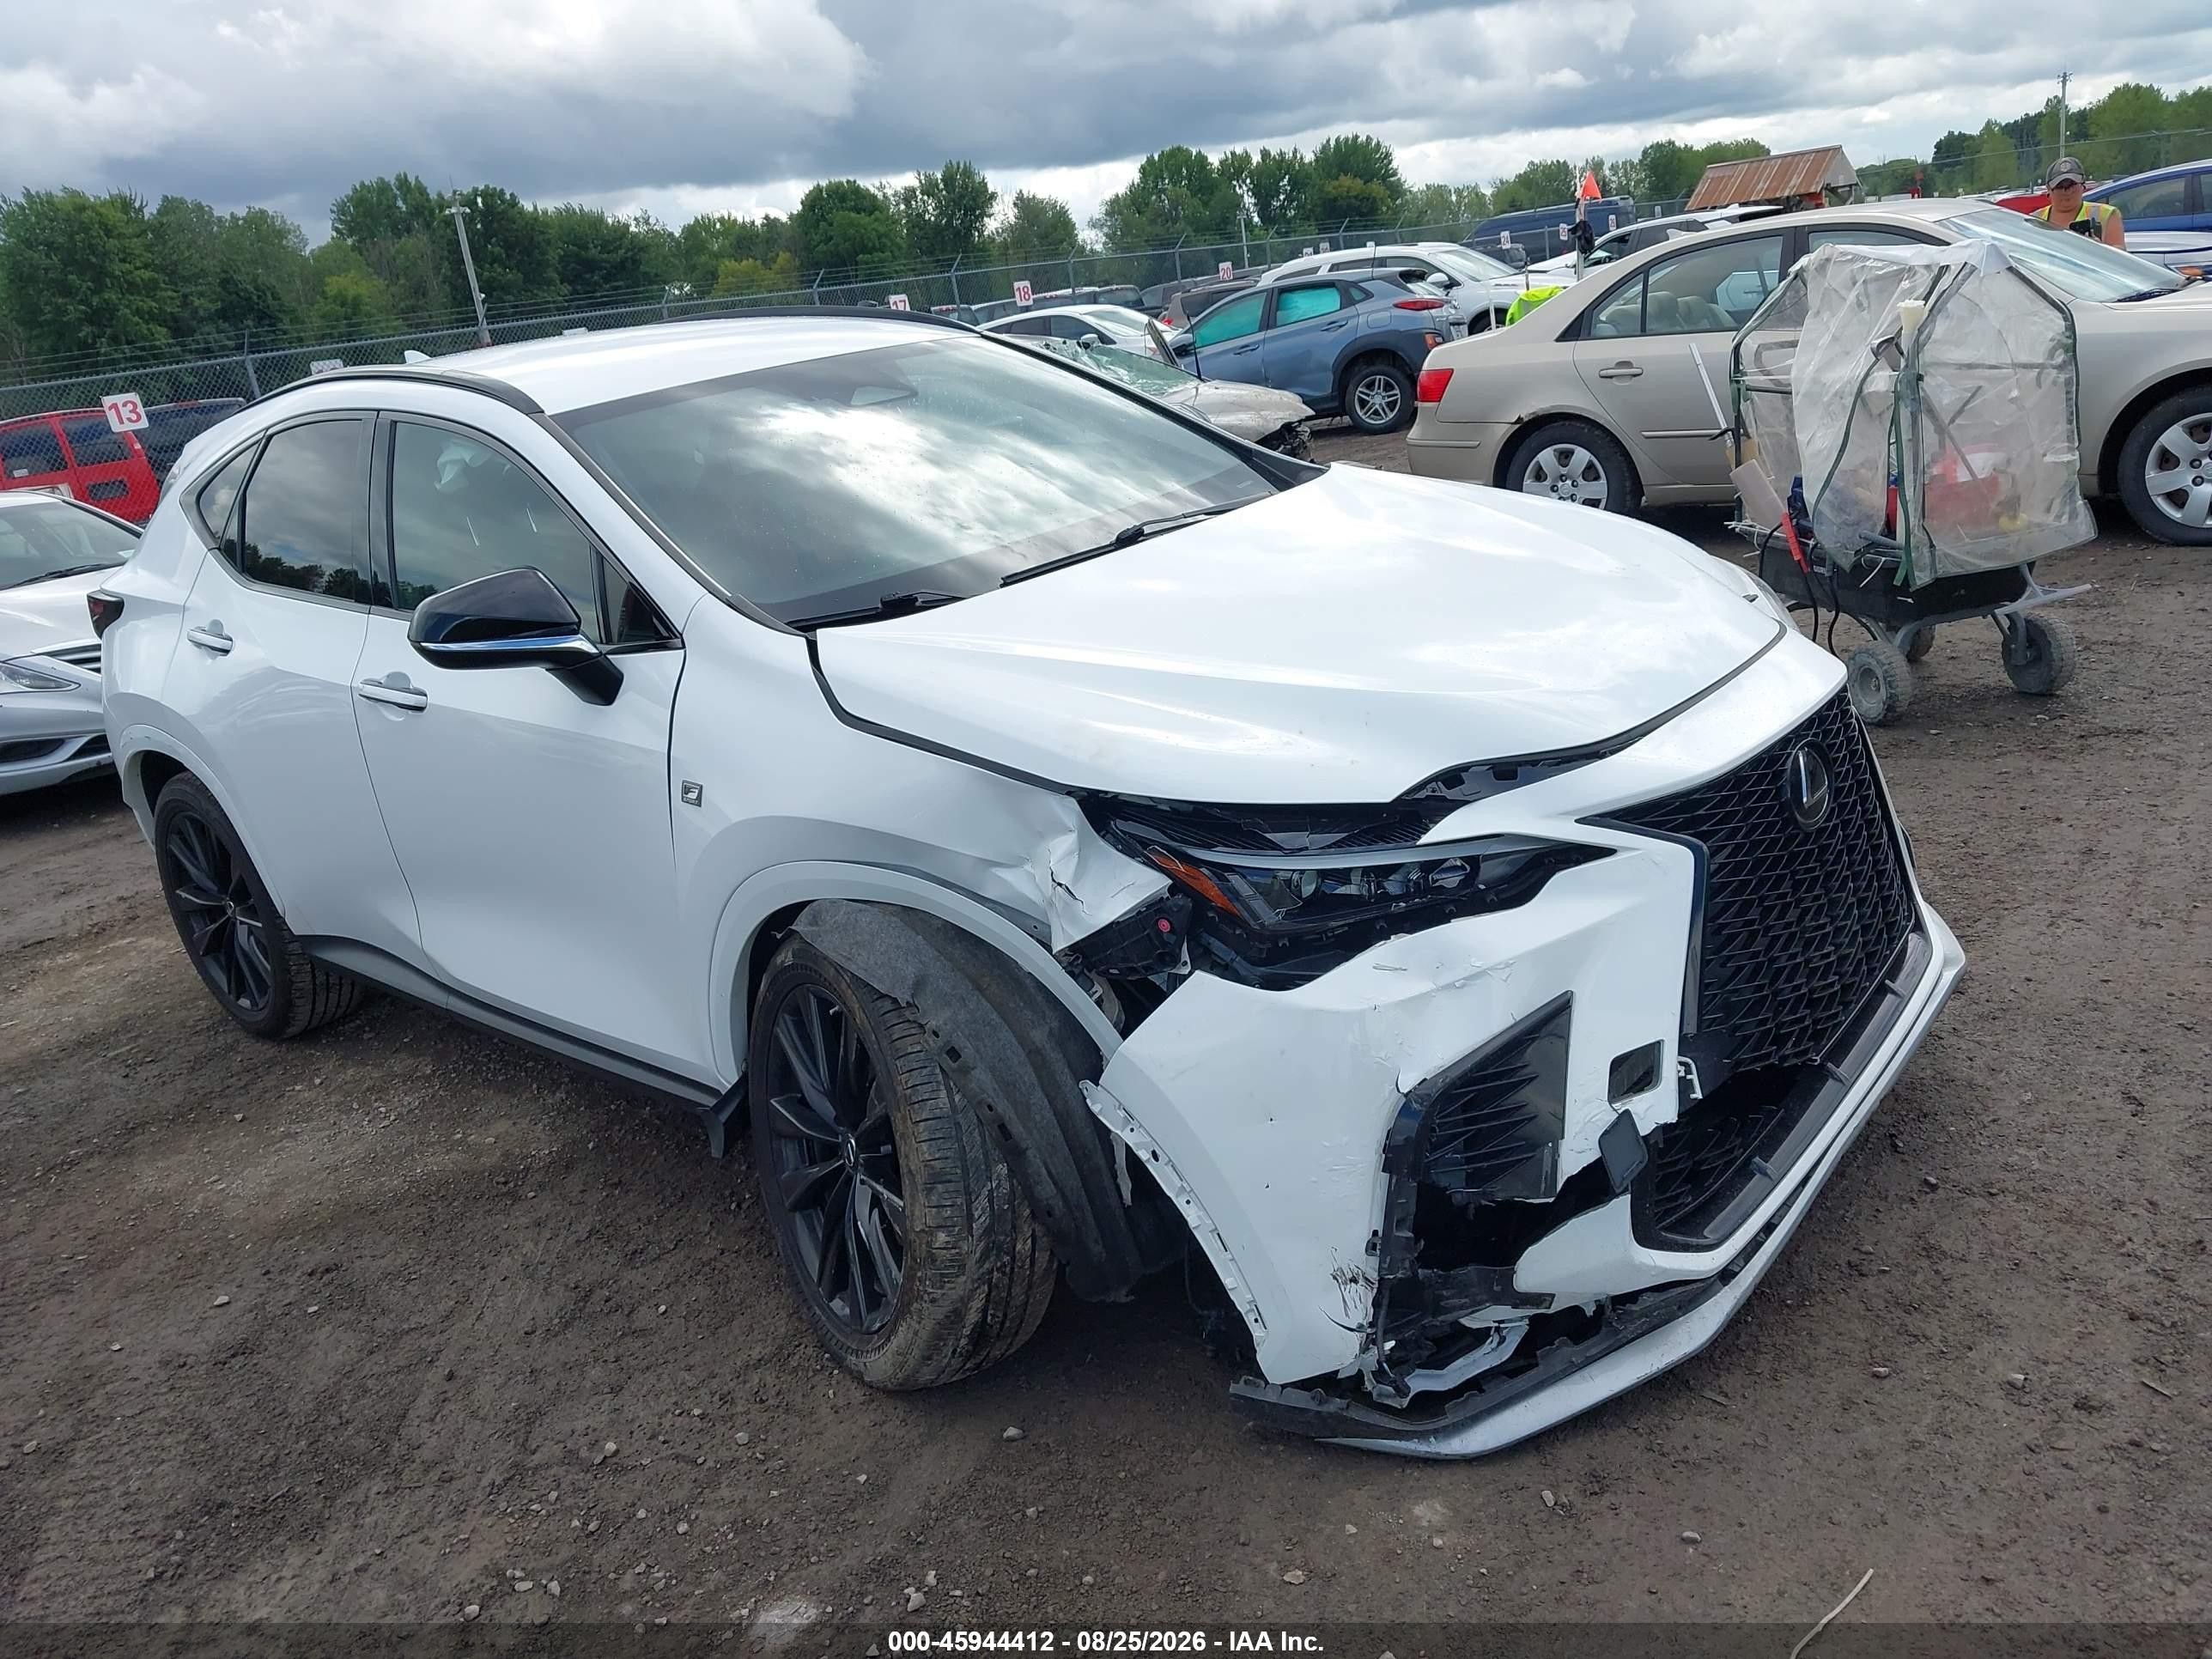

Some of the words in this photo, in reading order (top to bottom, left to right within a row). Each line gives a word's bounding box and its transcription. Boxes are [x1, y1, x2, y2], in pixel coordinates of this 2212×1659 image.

[1501, 235, 1510, 246] 24
[1220, 267, 1231, 280] 20
[1016, 285, 1030, 301] 18
[108, 400, 142, 425] 13
